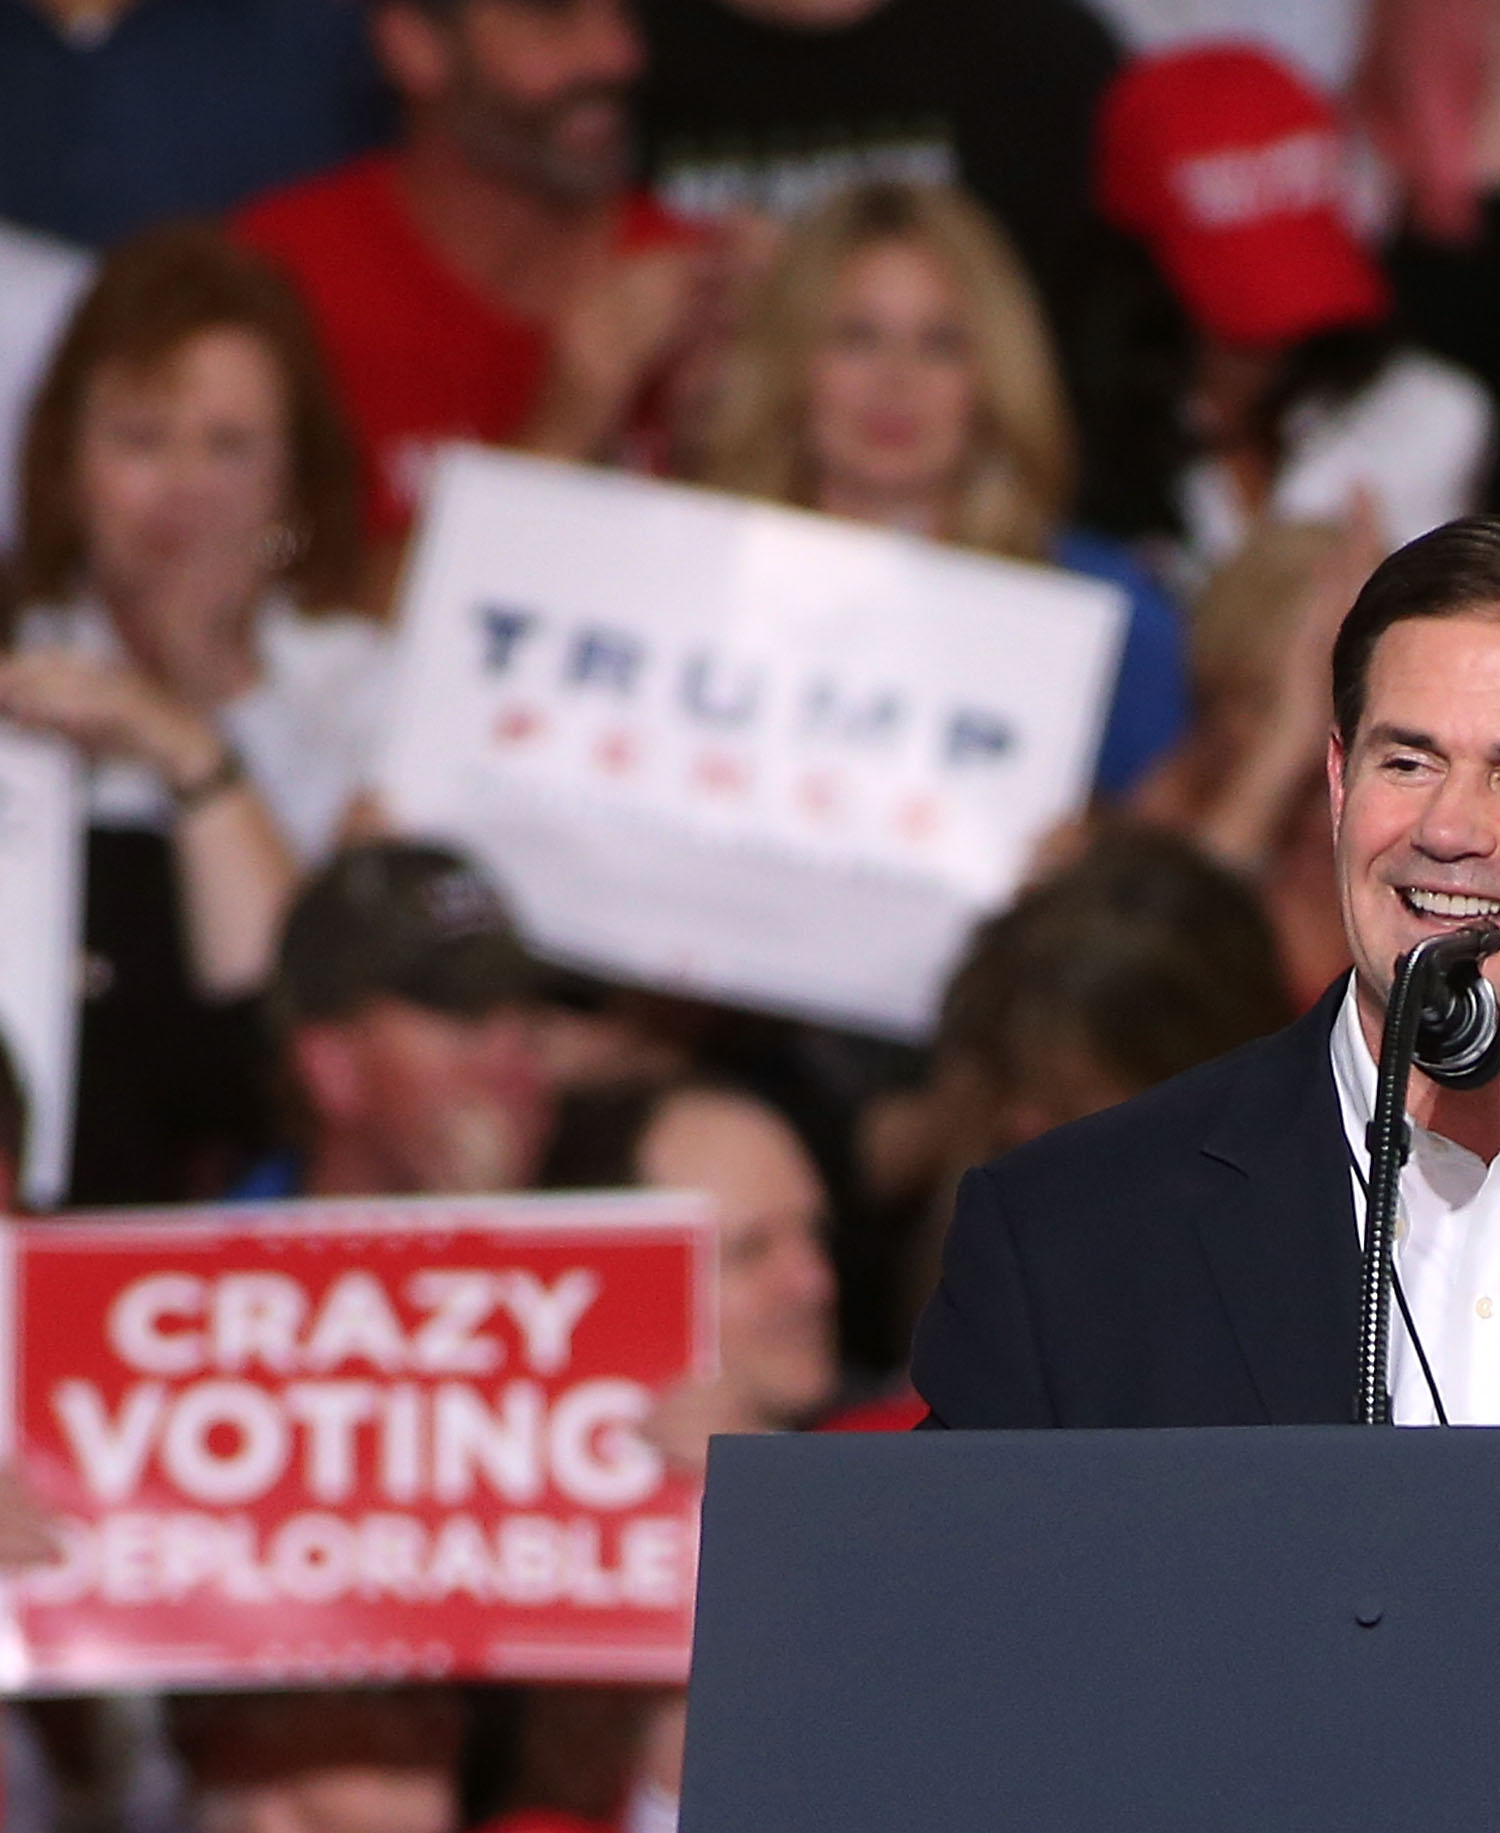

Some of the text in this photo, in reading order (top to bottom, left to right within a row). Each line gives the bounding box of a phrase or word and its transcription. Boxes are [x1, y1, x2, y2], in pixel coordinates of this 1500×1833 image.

[474, 602, 1022, 768] TRUMP
[106, 1268, 602, 1378] CRAZY
[50, 1374, 668, 1507] VOTING
